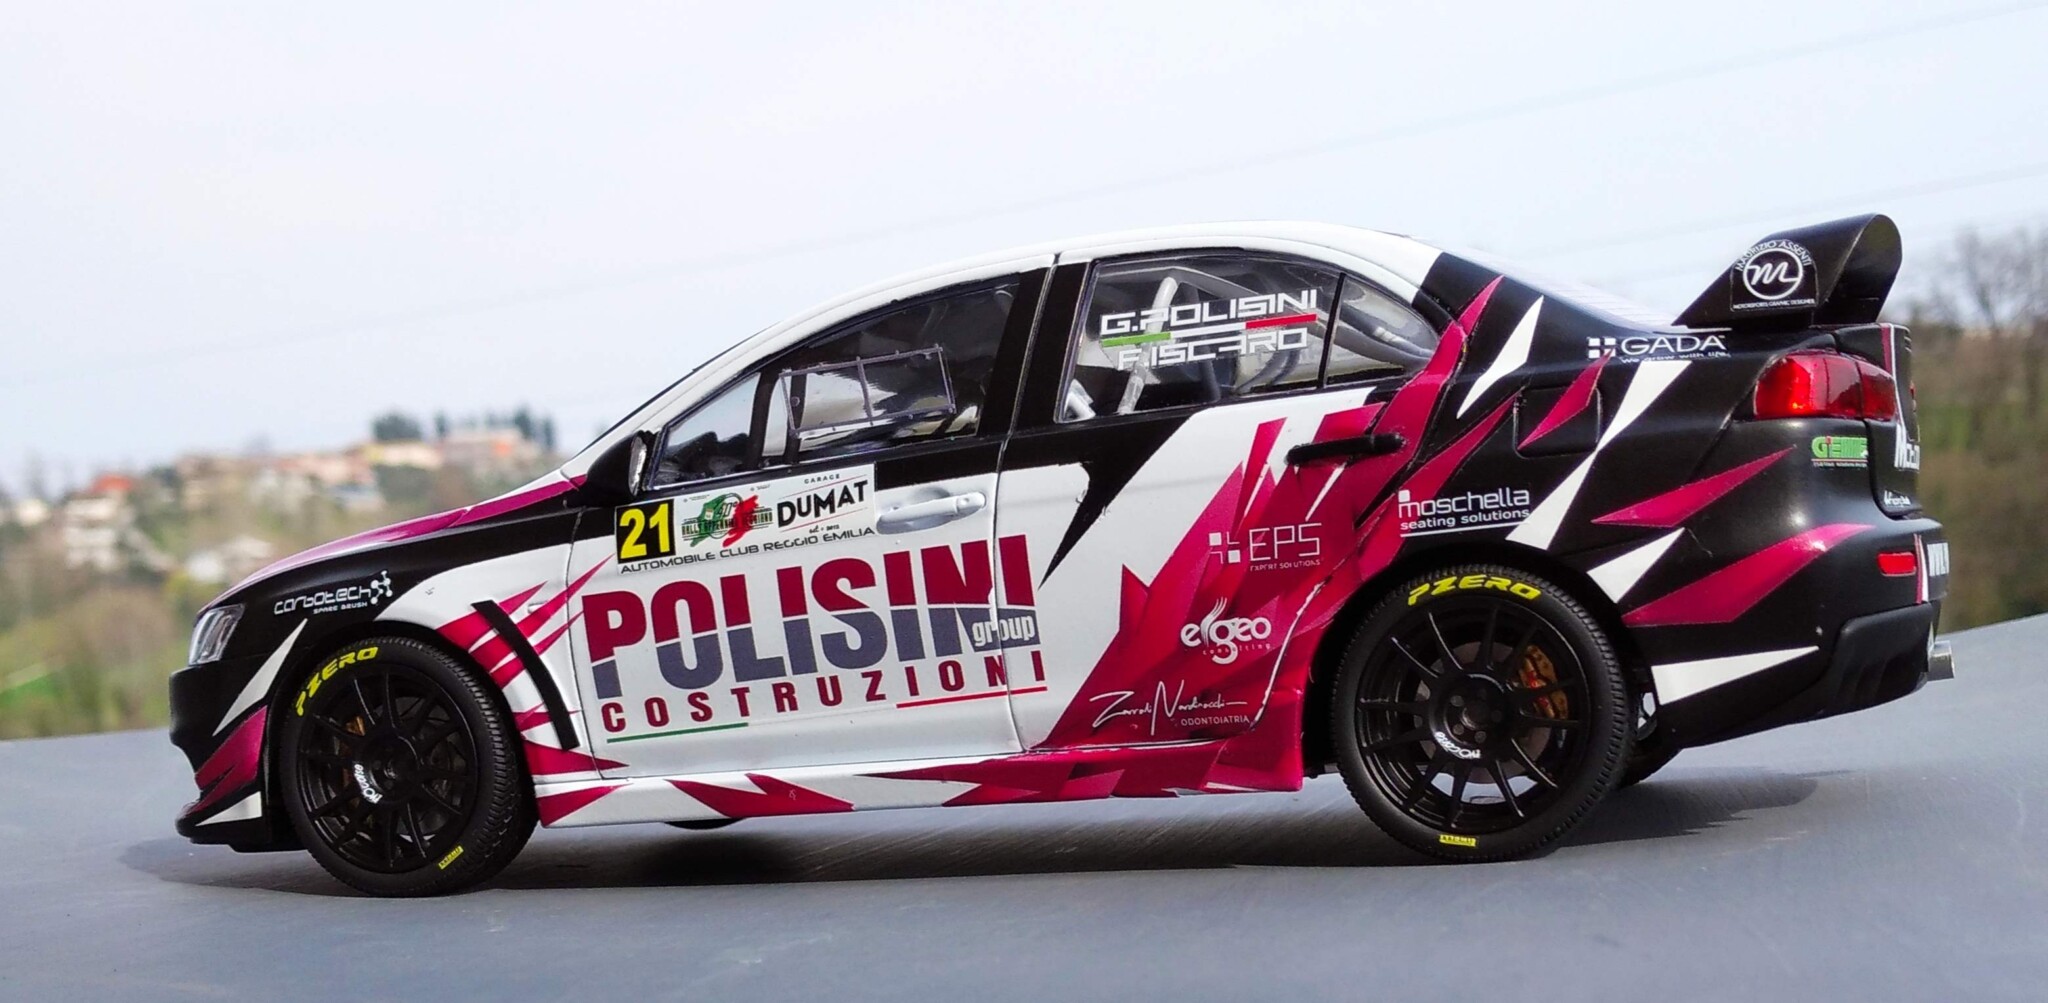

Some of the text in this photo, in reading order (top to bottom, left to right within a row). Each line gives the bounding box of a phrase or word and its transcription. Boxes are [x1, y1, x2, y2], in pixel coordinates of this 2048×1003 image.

[1778, 241, 1813, 266] ASSENTI
[1621, 336, 1727, 355] GADA
[777, 480, 868, 528] DUMAT
[1398, 487, 1530, 518] moschella
[620, 504, 671, 560] 21
[1400, 508, 1530, 534] seating solutions
[620, 527, 875, 574] AUTOMOBILE CLUB REGGIO EMILIA
[1249, 523, 1322, 561] EPS
[1250, 559, 1320, 571] EXPERT SOLUTIONS
[274, 586, 371, 615] carbotech
[1408, 574, 1541, 606] PZERO
[582, 534, 1038, 699] POLISINI
[972, 614, 1036, 646] group
[602, 650, 1046, 733] COSTRUZIONI
[1180, 715, 1250, 727] ODONTOIATRIA
